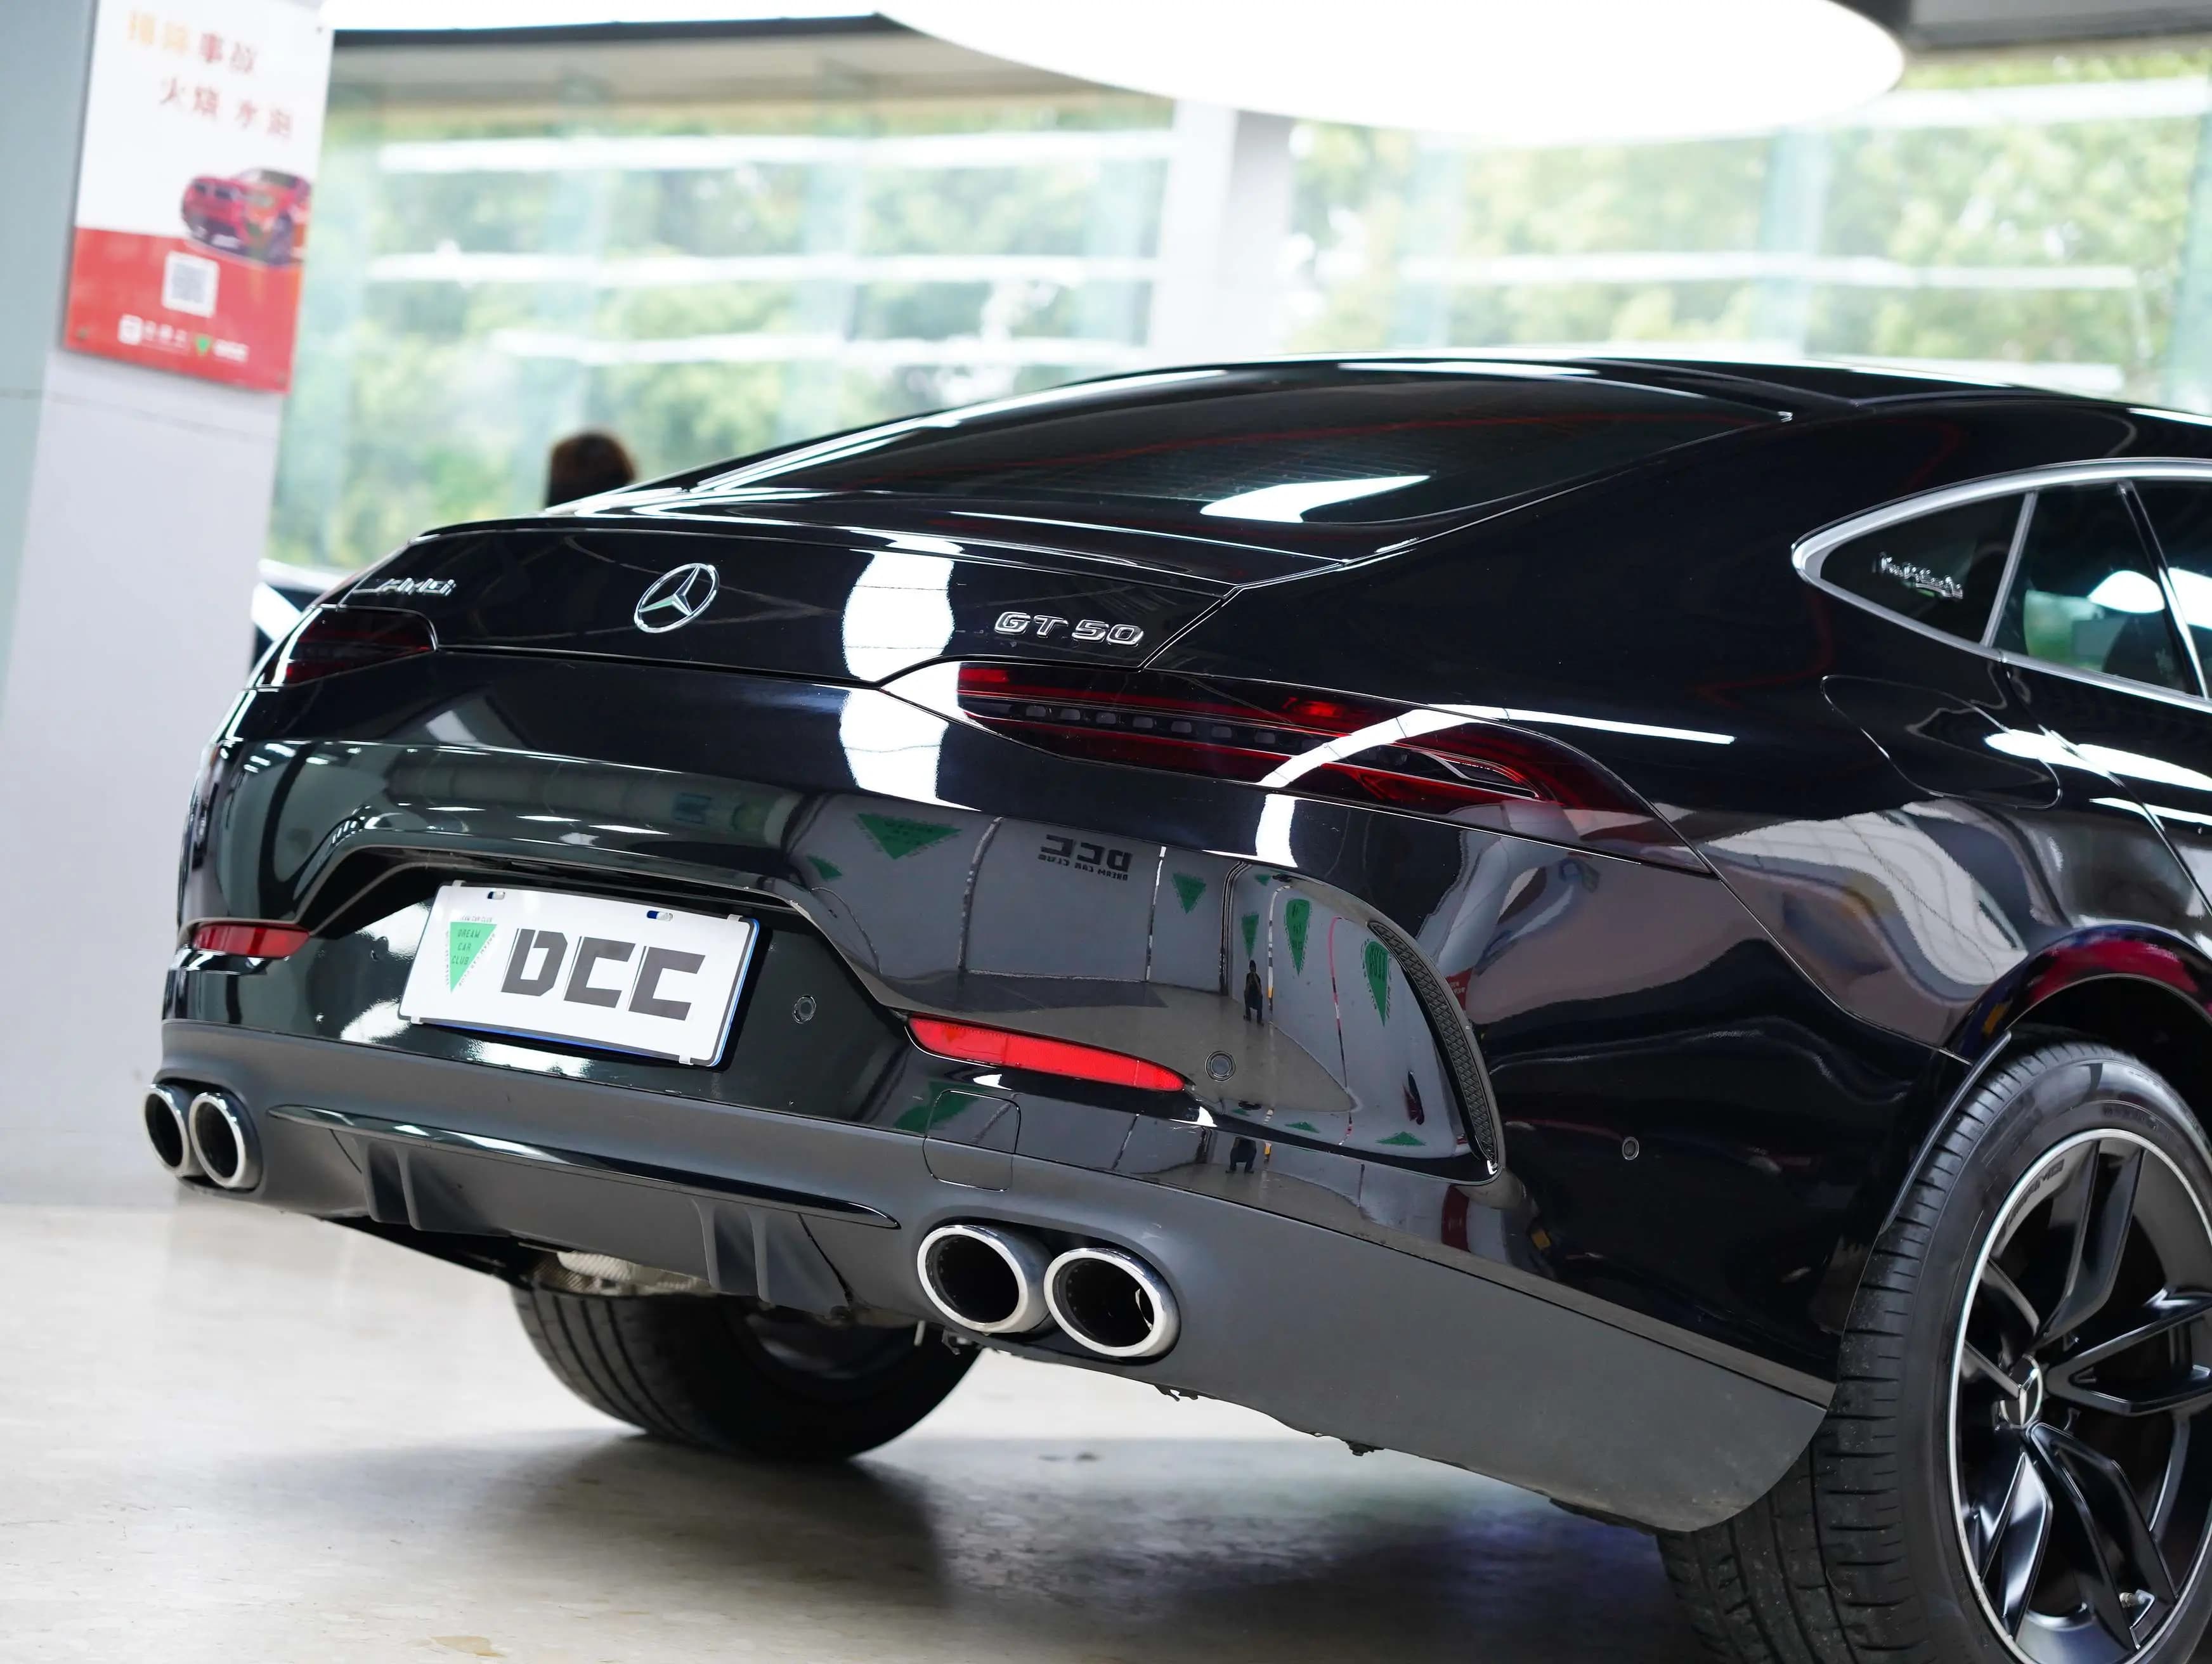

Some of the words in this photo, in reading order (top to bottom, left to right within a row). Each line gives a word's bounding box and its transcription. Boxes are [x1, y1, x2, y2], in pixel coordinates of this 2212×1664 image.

[994, 611, 1069, 638] GT
[1071, 619, 1144, 647] 50
[457, 928, 481, 939] DREAM
[457, 942, 472, 952] CAR
[451, 955, 470, 965] CLUB
[500, 928, 705, 1021] DCC
